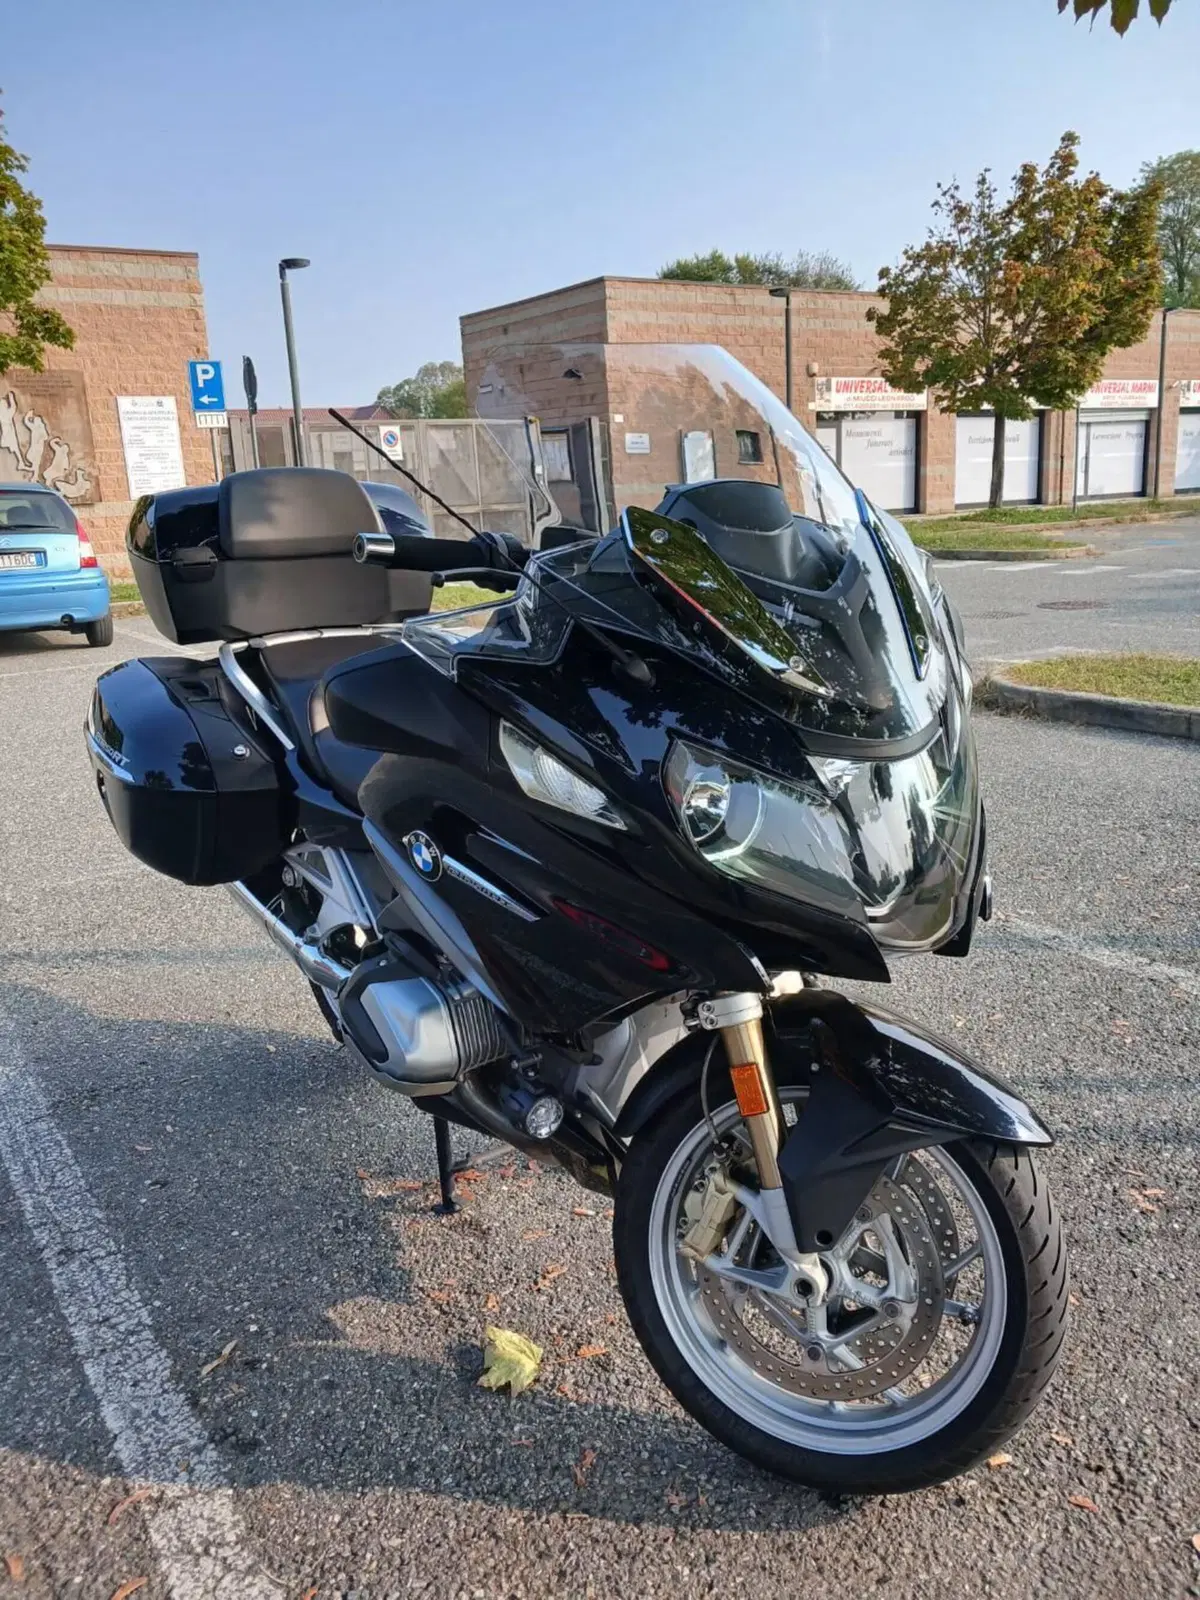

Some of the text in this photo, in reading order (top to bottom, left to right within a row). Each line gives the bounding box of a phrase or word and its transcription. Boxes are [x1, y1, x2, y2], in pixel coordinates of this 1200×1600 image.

[196, 364, 215, 388] P
[835, 380, 888, 393] UNIVERSAL
[1131, 382, 1156, 392] MARMI
[410, 835, 437, 857] BMW
